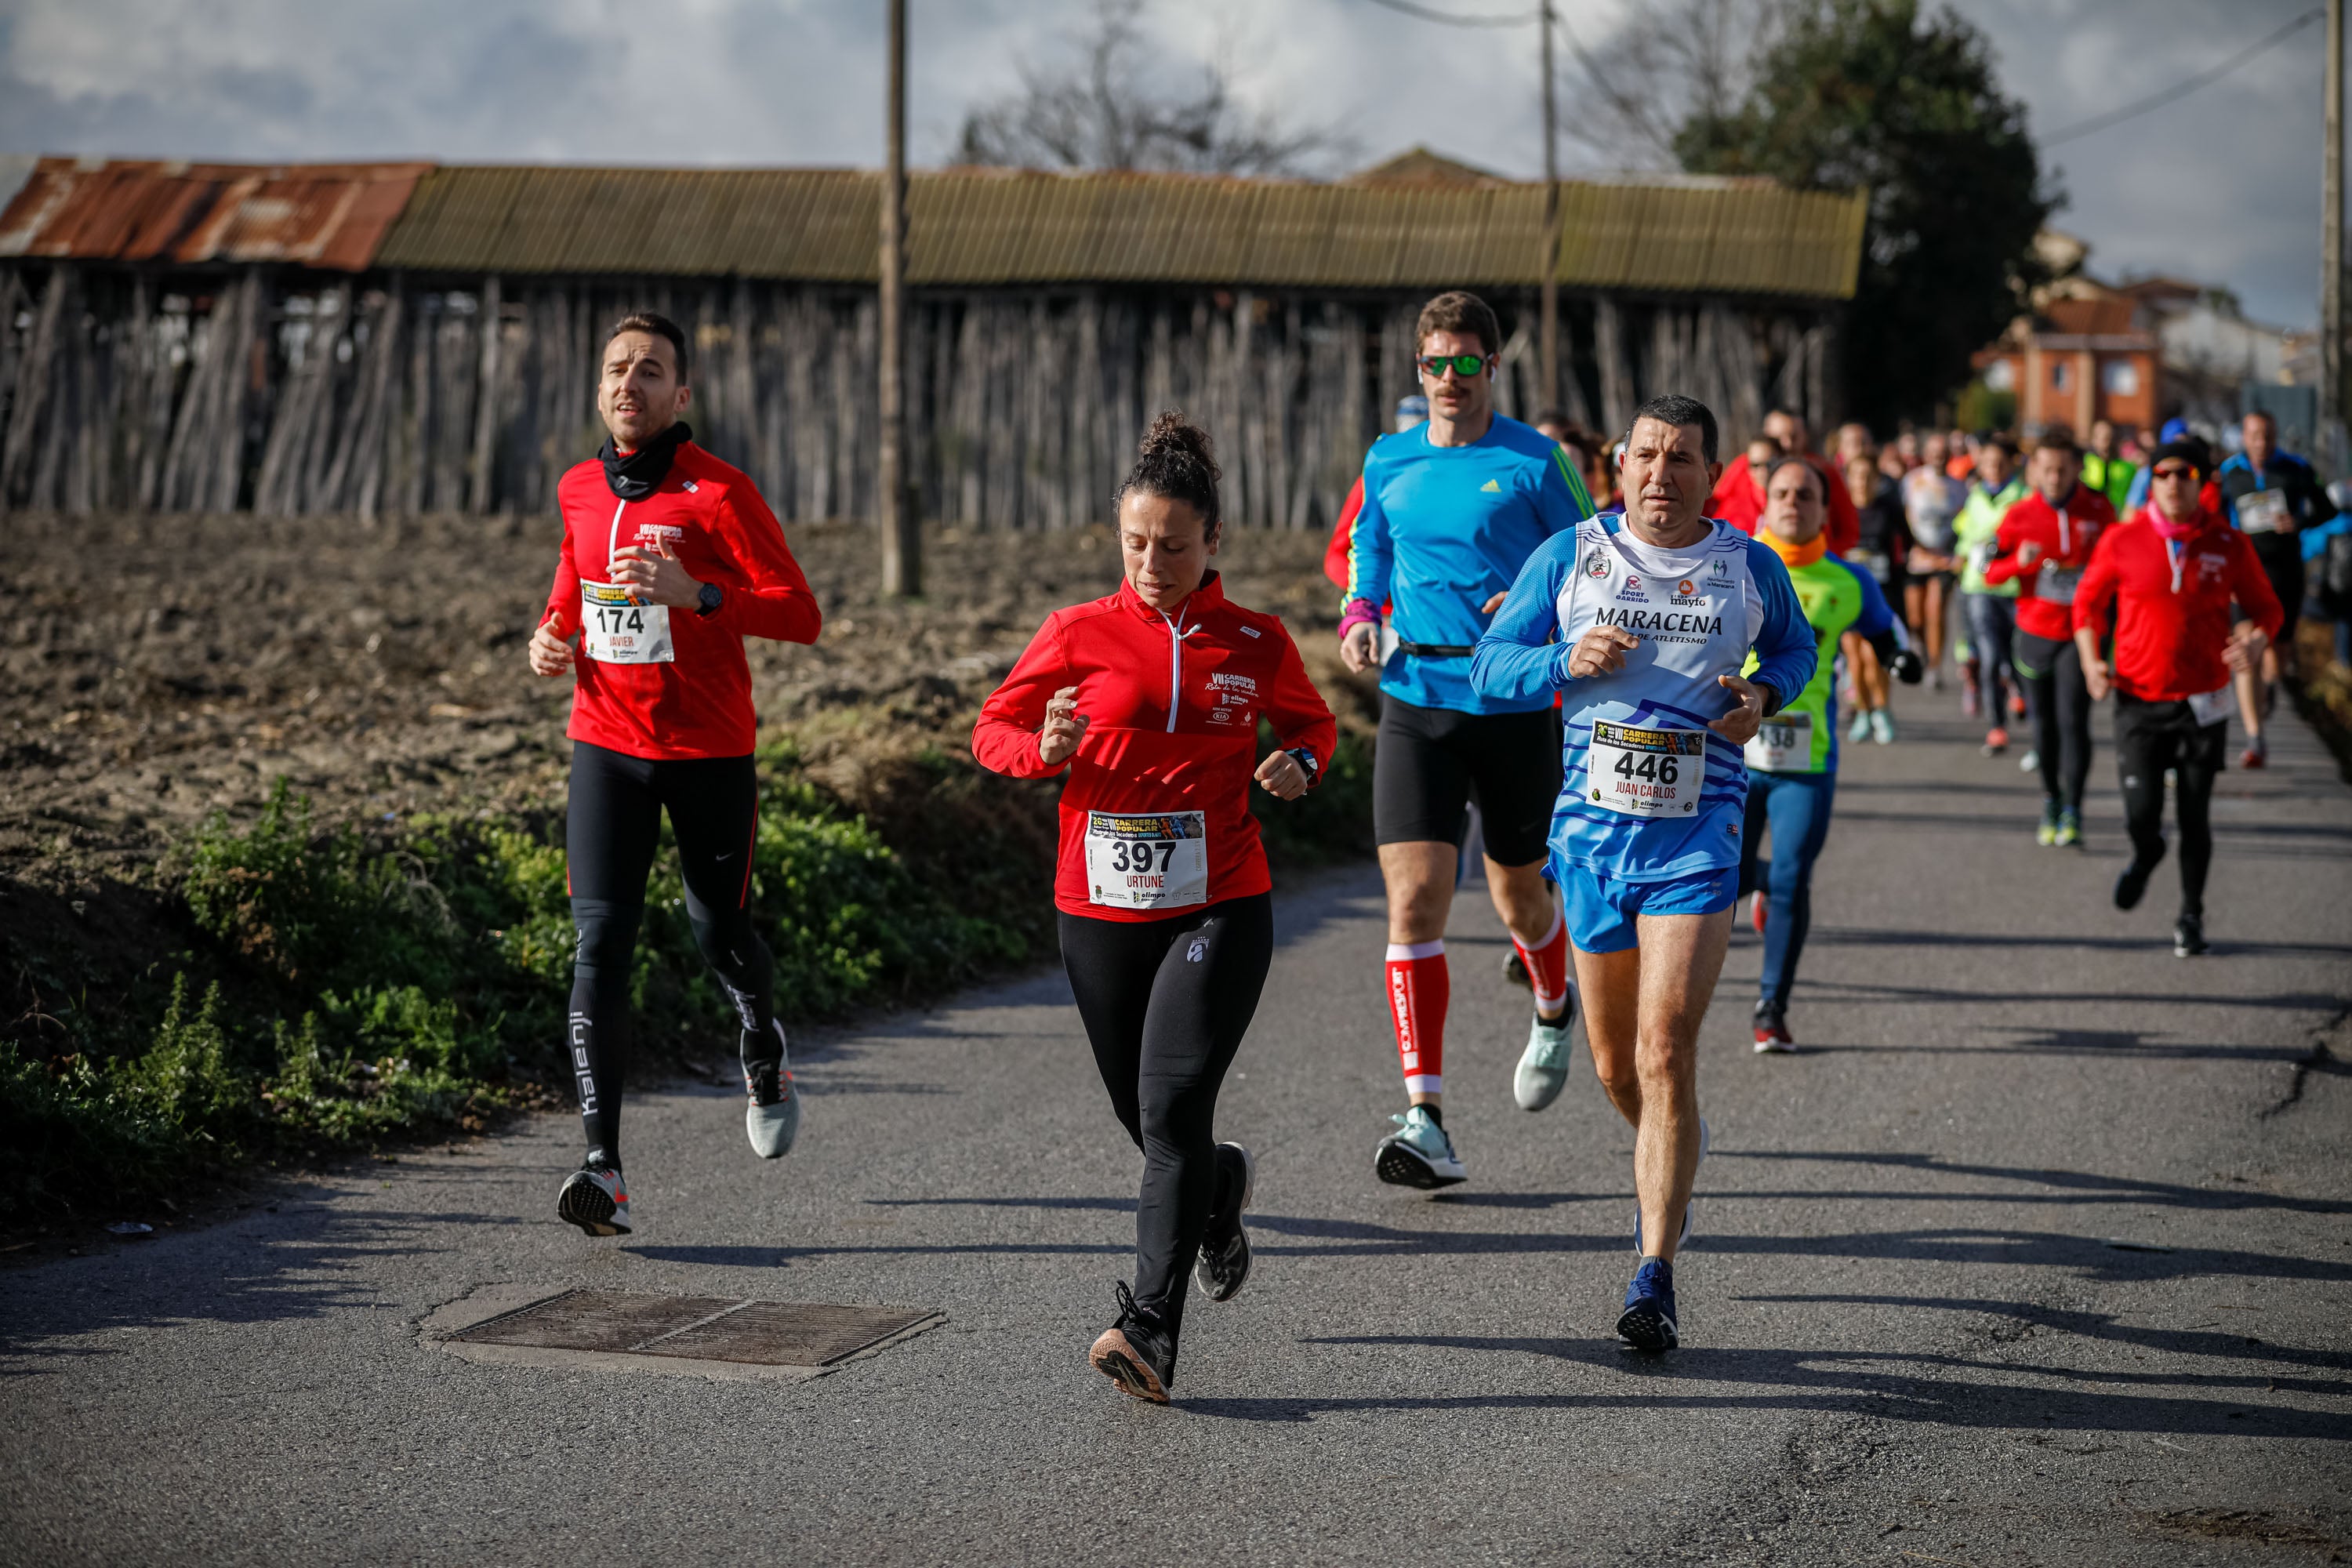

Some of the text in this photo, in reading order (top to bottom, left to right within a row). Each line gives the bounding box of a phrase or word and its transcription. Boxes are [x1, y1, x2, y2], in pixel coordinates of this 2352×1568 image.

[1616, 595, 1650, 604] GARRIDO
[1670, 597, 1706, 608] mayfo
[597, 608, 644, 633] 174
[1595, 607, 1722, 635] MARACENA
[1651, 635, 1708, 644] ATLETISMO
[1212, 673, 1256, 684] VII CARRERA
[1224, 679, 1256, 691] POPULAR
[1615, 727, 1624, 740] VII
[1623, 728, 1665, 740] CARRERA
[1620, 740, 1645, 750] Secaderos
[1623, 735, 1664, 746] POPULAR
[1614, 752, 1679, 785] 446
[1615, 781, 1676, 799] JUAN CARLOS
[1093, 817, 1102, 826] 26
[1112, 842, 1177, 873] 397
[1127, 875, 1164, 888] URTUNE
[569, 1011, 598, 1116] kalenji
